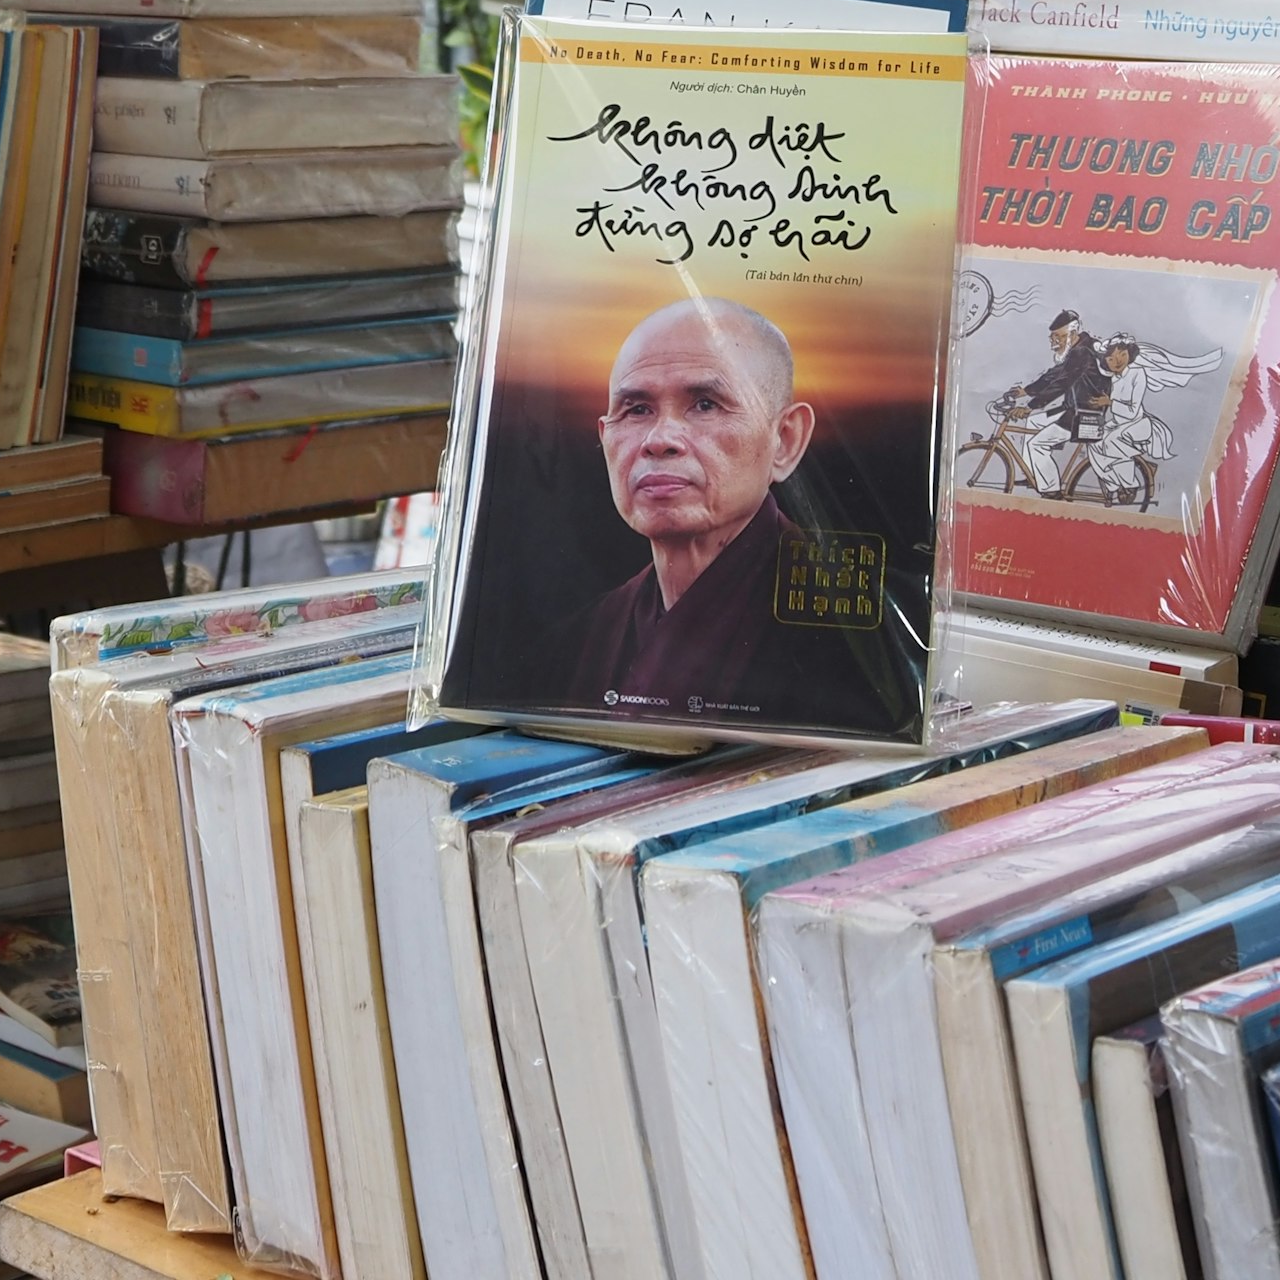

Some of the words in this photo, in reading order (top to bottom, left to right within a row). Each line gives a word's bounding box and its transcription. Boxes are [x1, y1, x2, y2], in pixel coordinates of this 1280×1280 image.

[1030, 0, 1120, 31] Canfield
[1144, 7, 1210, 41] Những
[549, 45, 569, 60] No
[575, 46, 627, 64] Death,
[634, 48, 654, 64] No
[660, 49, 705, 67] Fear:
[710, 52, 802, 72] Comforting
[809, 55, 870, 74] Wisdom
[876, 59, 903, 75] for
[909, 59, 943, 77] Life
[668, 79, 708, 96] Người
[707, 81, 736, 96] dịch:
[735, 82, 768, 97] Chân
[769, 83, 808, 99] Huyền
[1011, 84, 1089, 101] THÀNH
[1096, 87, 1174, 104] PHONG
[747, 114, 847, 170] diệt
[1006, 130, 1177, 178] THƯƠNG
[788, 164, 900, 216] sinh
[978, 175, 1073, 230] THỜI
[1084, 191, 1170, 236] BAO
[1184, 188, 1274, 244] CẤP
[789, 539, 877, 569] Thích
[789, 564, 872, 592] Nhất
[787, 589, 874, 619] Hạnh
[619, 694, 670, 707] SAIGONBOOKS
[1032, 933, 1063, 957] First
